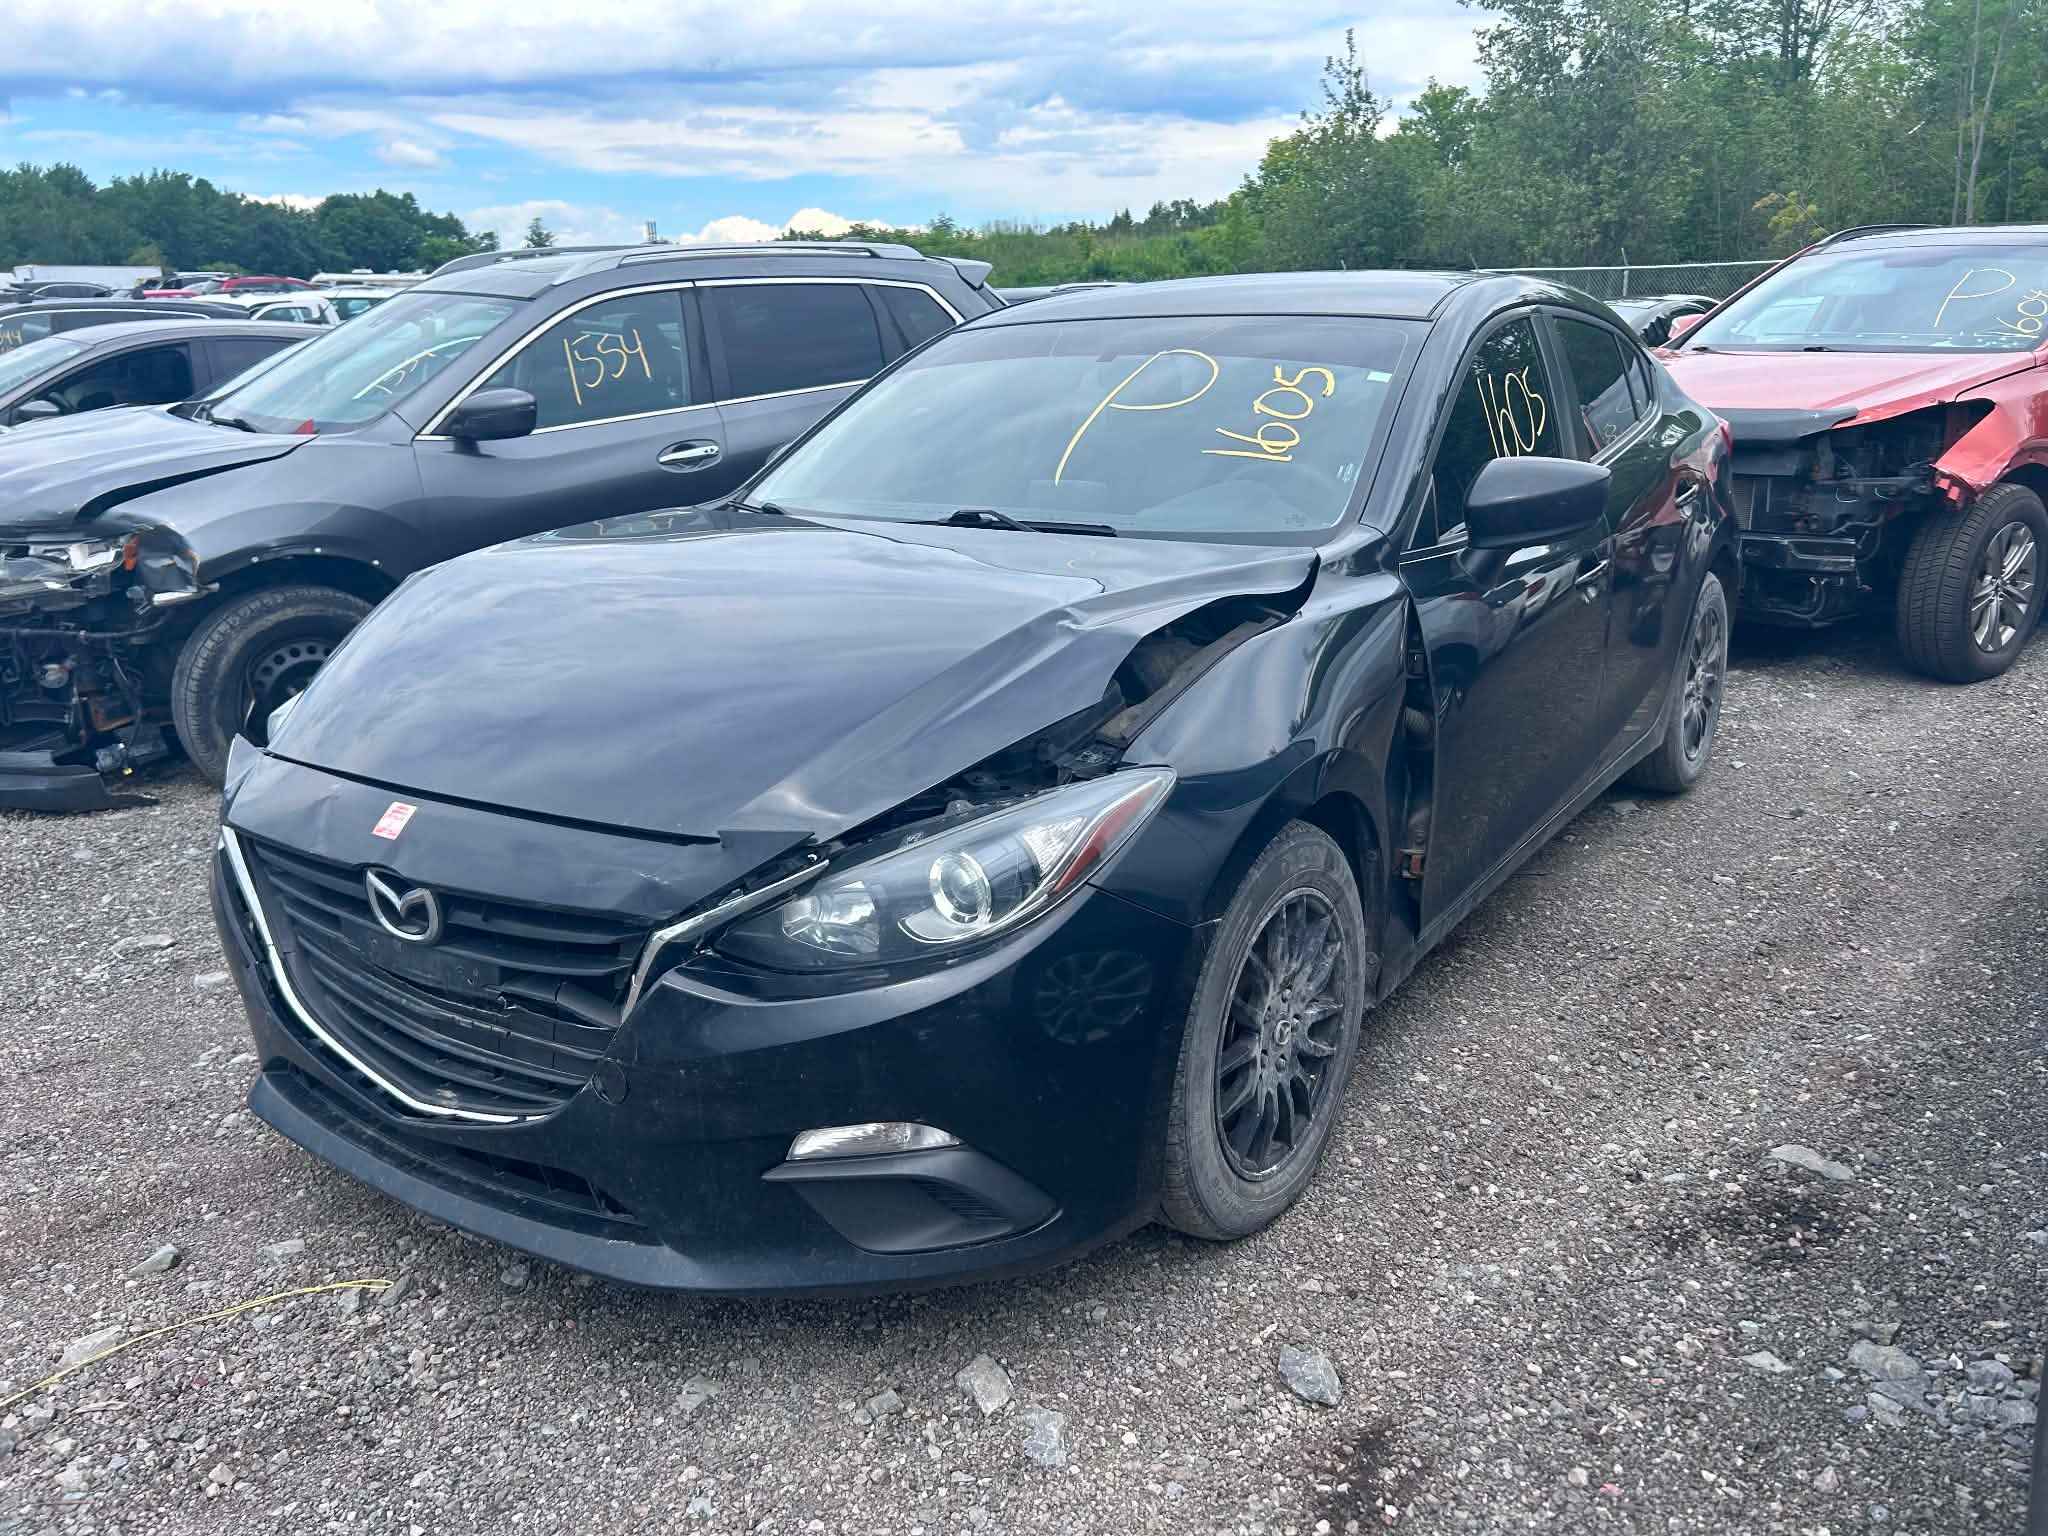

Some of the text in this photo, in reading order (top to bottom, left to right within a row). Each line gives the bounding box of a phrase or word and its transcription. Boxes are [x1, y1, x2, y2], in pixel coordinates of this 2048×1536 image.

[1934, 267, 2016, 328] P
[563, 328, 651, 406] 1554
[1477, 366, 1546, 458] 1605
[1055, 348, 1220, 486] P
[1201, 365, 1336, 462] 1605
